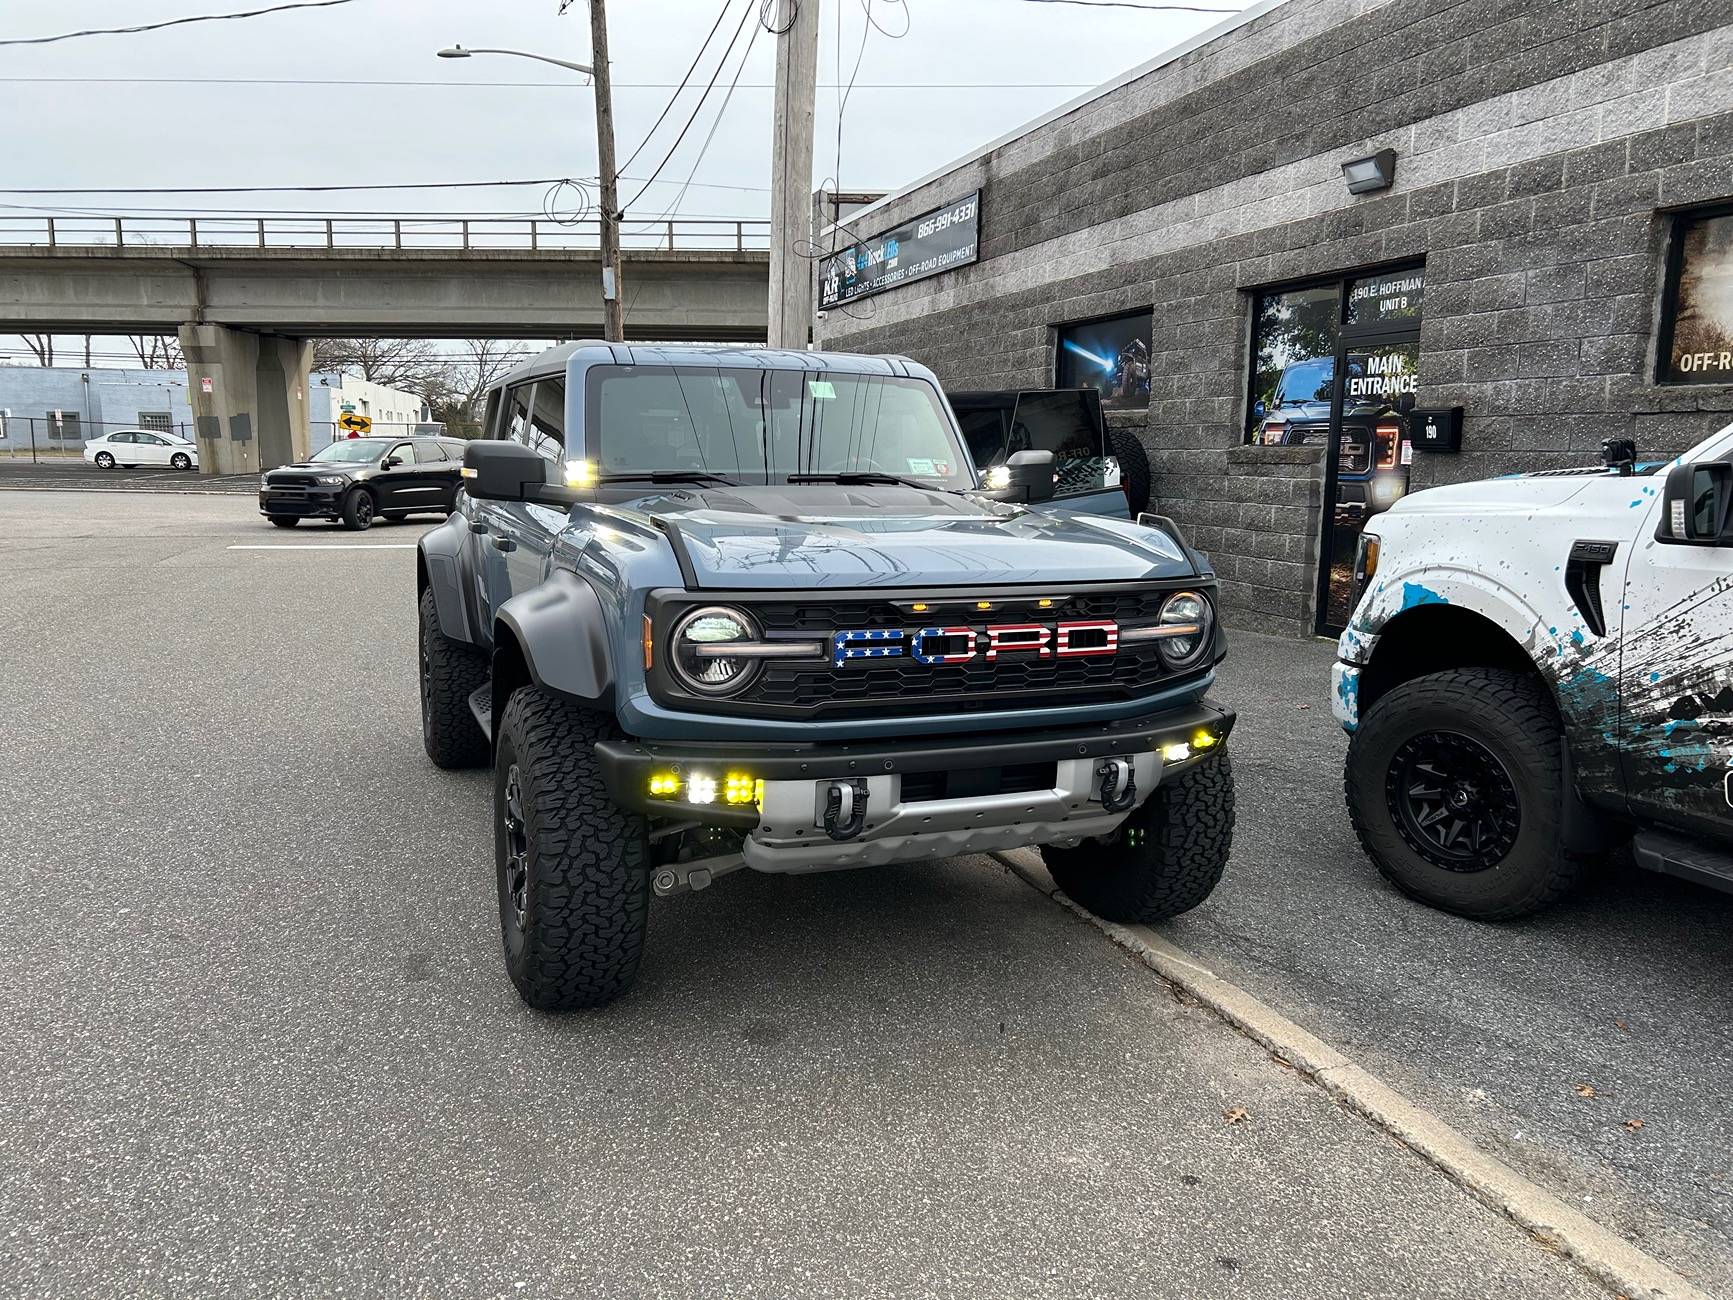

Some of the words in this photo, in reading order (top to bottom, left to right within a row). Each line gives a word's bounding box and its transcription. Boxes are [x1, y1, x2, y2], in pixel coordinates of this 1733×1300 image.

[918, 201, 976, 239] 866-991-4331
[845, 286, 854, 298] LED
[854, 281, 870, 295] LIGHTS
[872, 268, 905, 288] ACCESSORIES
[908, 257, 937, 276] OFF-ROAD
[938, 244, 975, 266] EQUIPMENT
[1354, 287, 1369, 300] 190
[1370, 285, 1378, 297] E.
[1380, 277, 1422, 296] HOFFMAN
[1380, 297, 1400, 312] UNIT
[1401, 296, 1408, 309] B
[1367, 355, 1404, 375] MAIN
[1680, 352, 1733, 372] OFF-R
[1350, 375, 1418, 396] ENTRANCE
[1426, 425, 1437, 439] 190
[833, 619, 1118, 668] FORD
